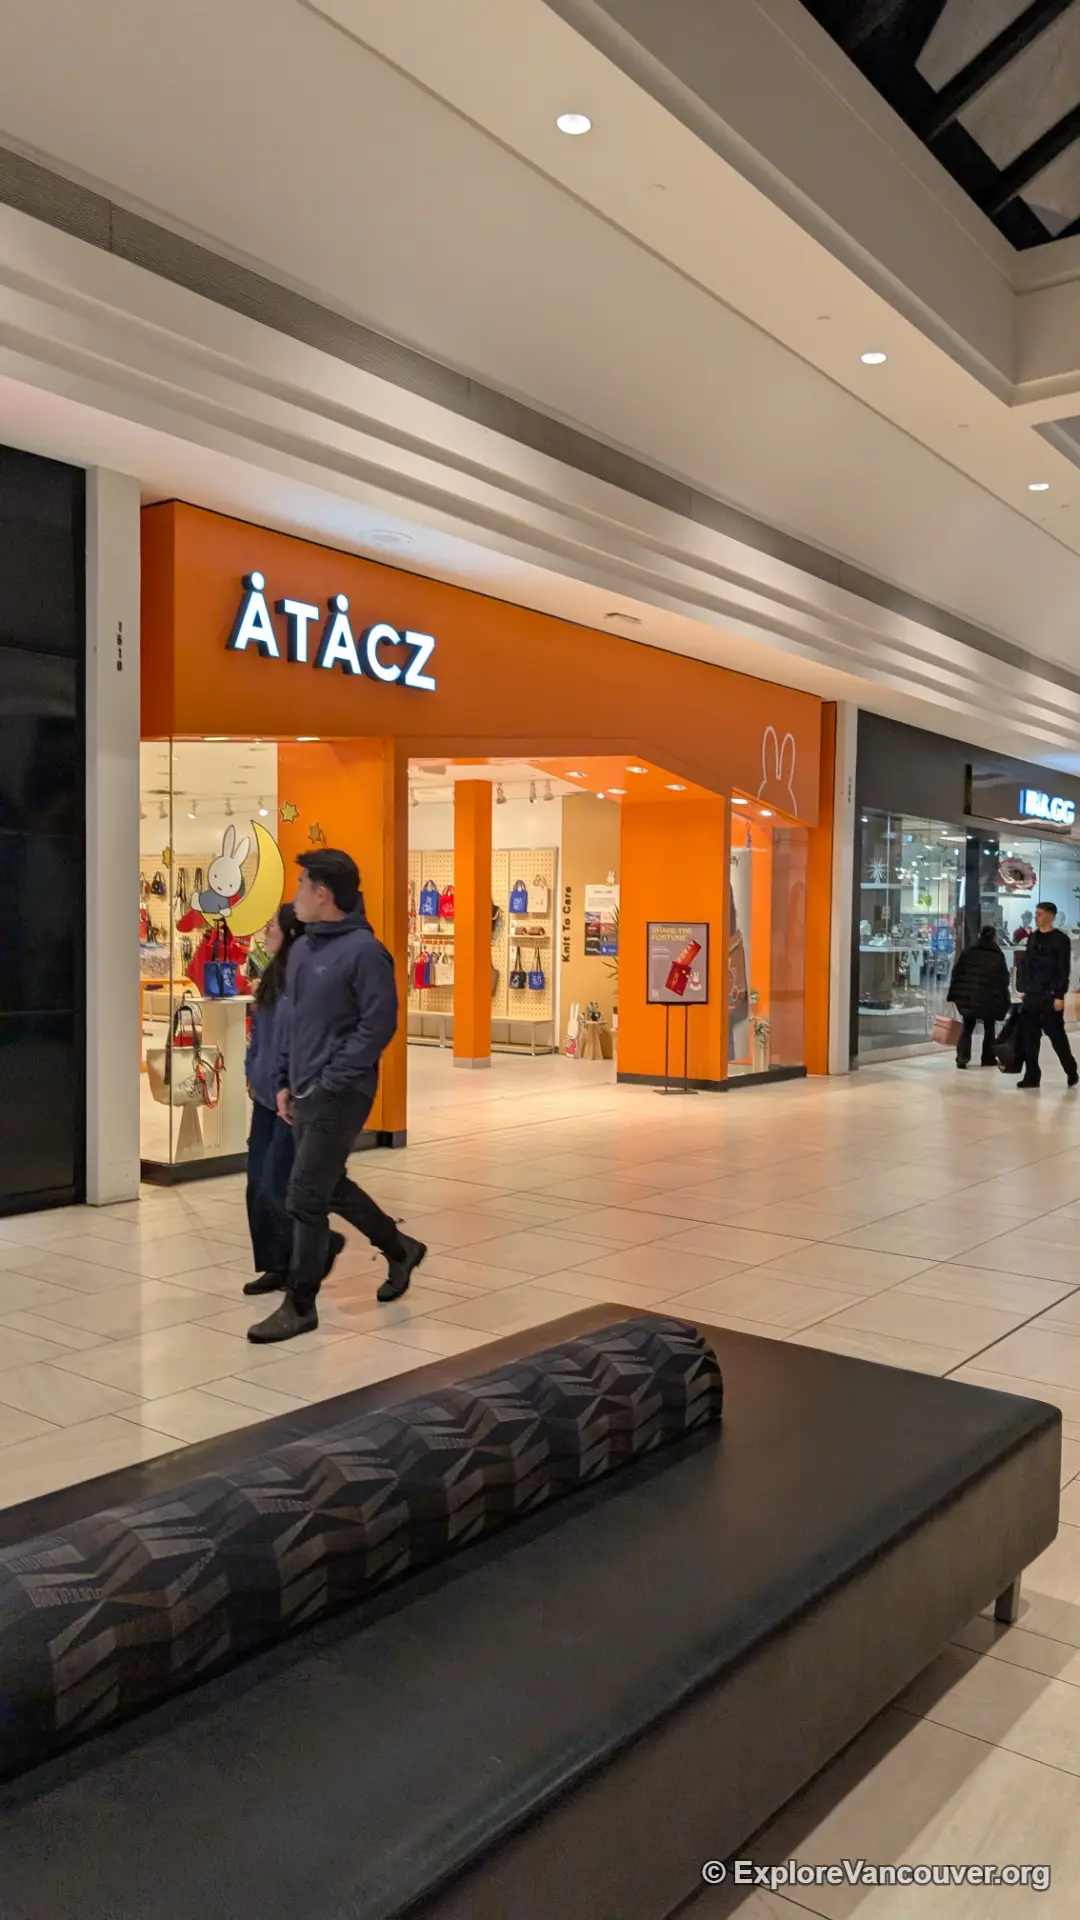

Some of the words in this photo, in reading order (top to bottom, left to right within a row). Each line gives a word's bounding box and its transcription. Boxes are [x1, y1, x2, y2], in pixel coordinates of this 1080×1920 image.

[562, 886, 572, 914] Care
[562, 918, 571, 932] To
[562, 936, 571, 962] Knit
